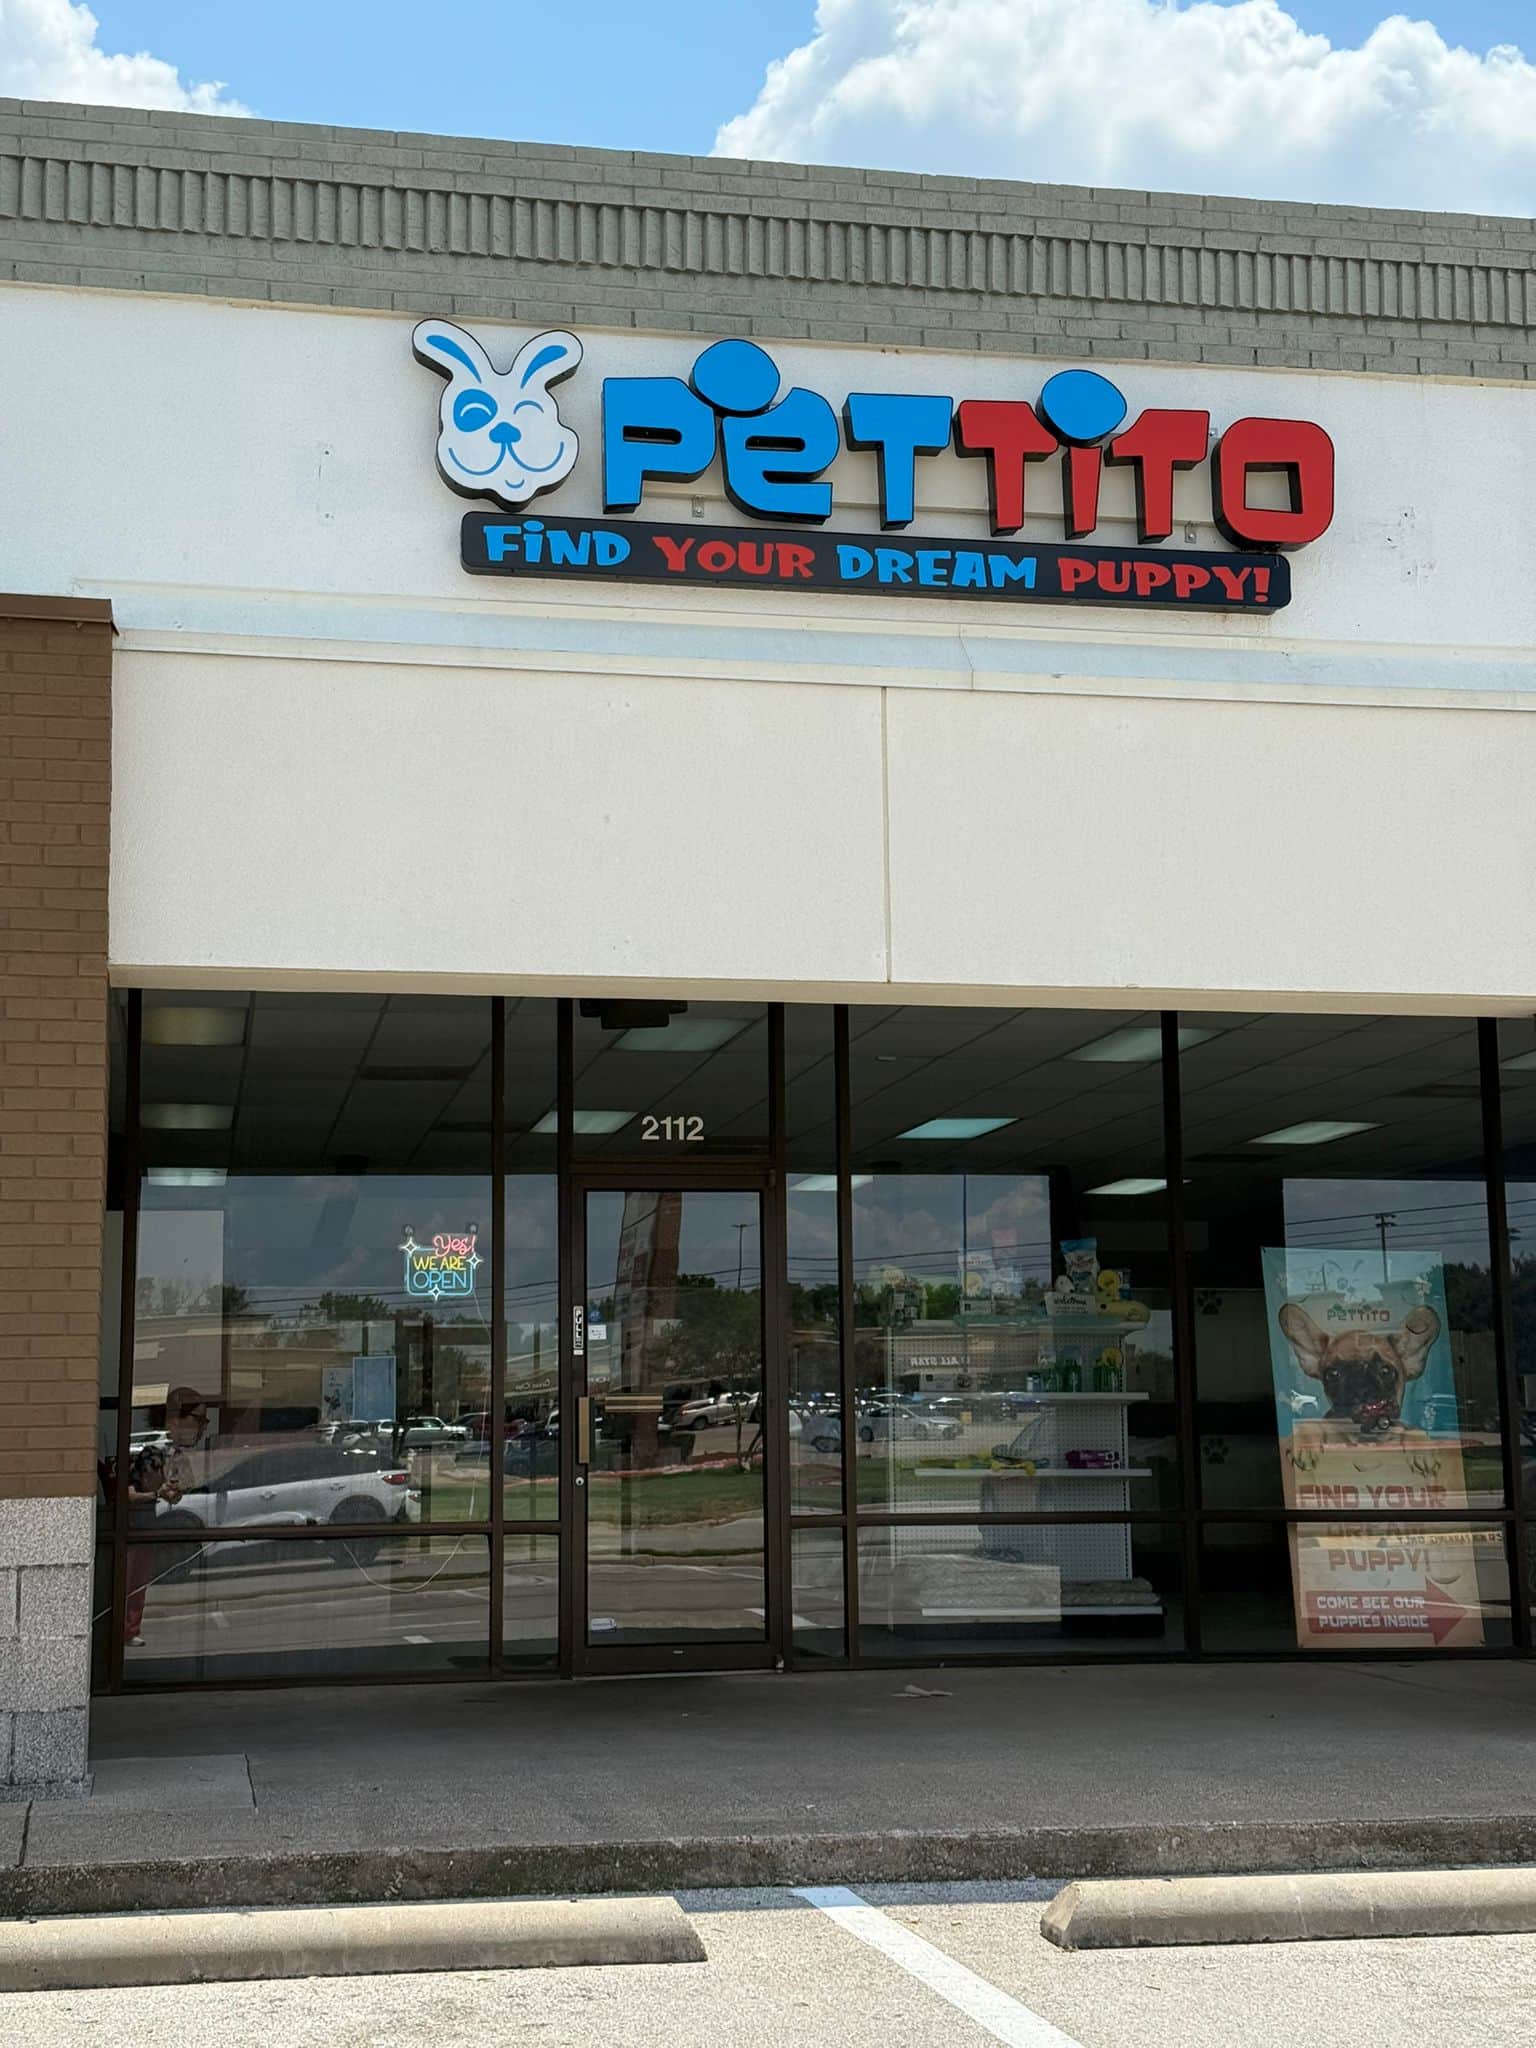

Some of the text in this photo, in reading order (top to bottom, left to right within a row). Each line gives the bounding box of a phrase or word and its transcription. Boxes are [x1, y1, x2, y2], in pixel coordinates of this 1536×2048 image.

[652, 535, 816, 578] YOUR
[836, 543, 1038, 590] DREAM
[1057, 557, 1271, 603] PUPPY!
[641, 1115, 705, 1140] 2112
[433, 1234, 477, 1257] Yes!
[413, 1255, 467, 1270] WE ARE
[413, 1270, 467, 1289] OPEN
[1299, 1485, 1447, 1508] FIND YOUR
[1328, 1549, 1431, 1572] PUPPY!
[1316, 1595, 1425, 1609] COME SEE OUR
[1318, 1615, 1430, 1628] PUPPIES INSIDE
